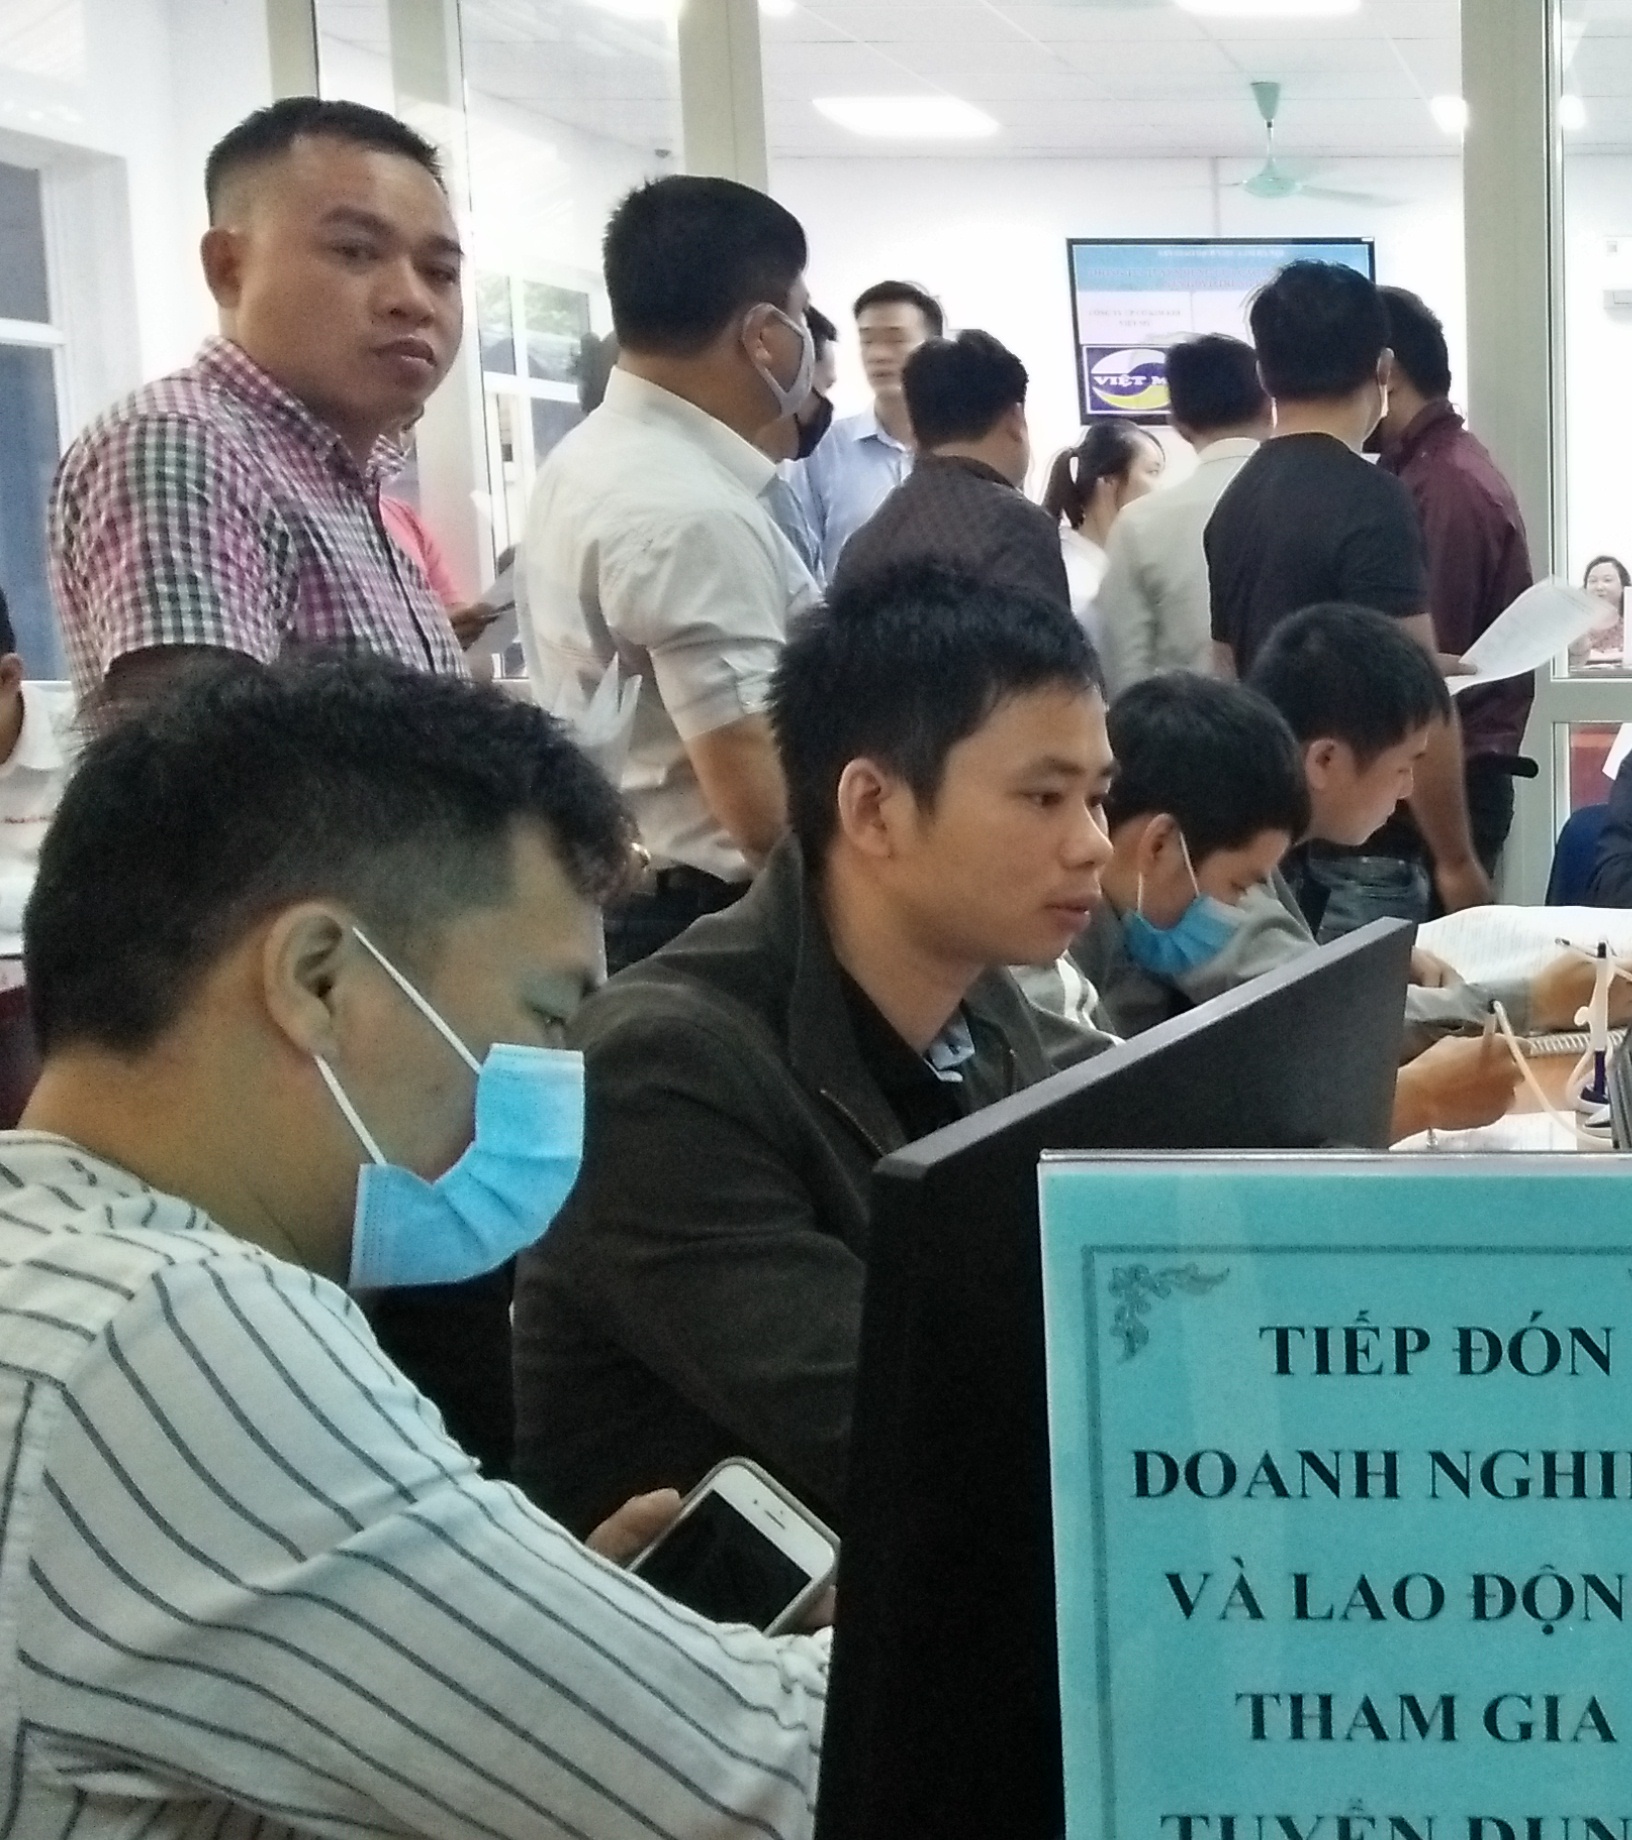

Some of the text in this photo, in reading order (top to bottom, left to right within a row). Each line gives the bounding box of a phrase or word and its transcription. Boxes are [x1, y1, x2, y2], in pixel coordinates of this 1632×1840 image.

[1258, 1310, 1616, 1377] TIẾP ĐÓN
[1131, 1448, 1400, 1500] DOANH
[1164, 1556, 1266, 1621] VÀ
[1290, 1571, 1446, 1622] LAO
[1234, 1692, 1619, 1743] THAM GIA
